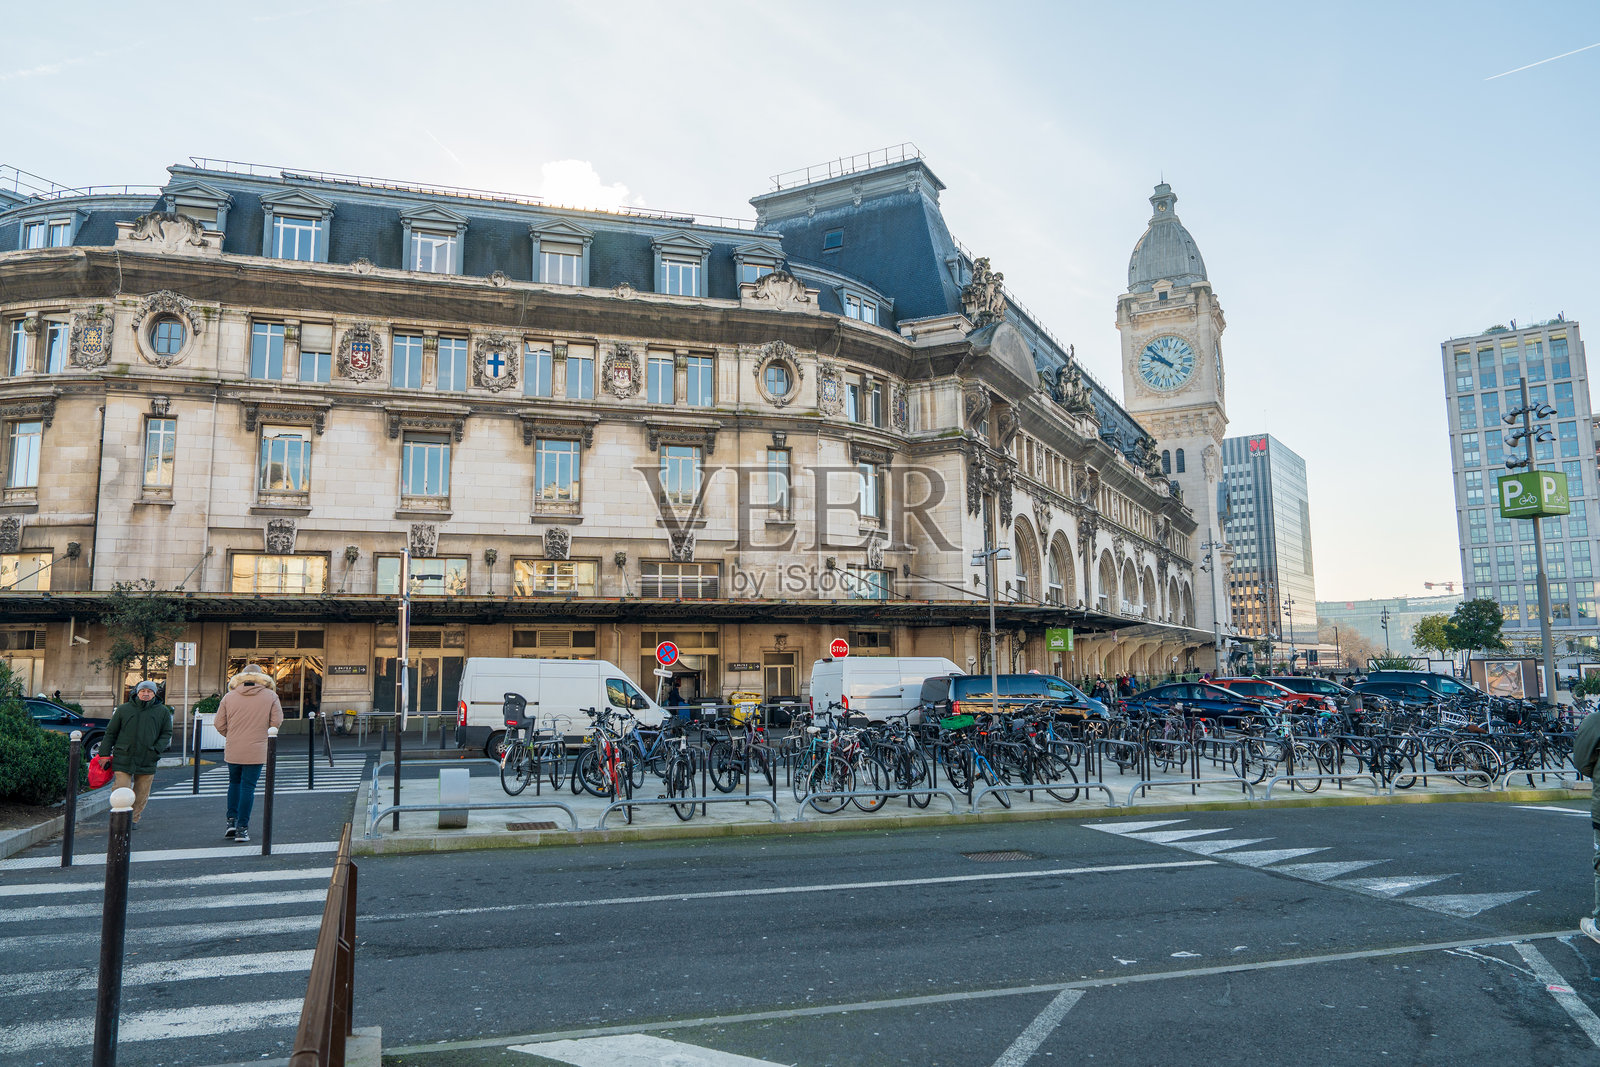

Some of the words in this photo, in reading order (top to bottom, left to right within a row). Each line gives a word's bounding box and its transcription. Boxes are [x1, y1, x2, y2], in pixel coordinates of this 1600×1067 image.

[1250, 450, 1267, 458] hotel
[1502, 480, 1523, 508] P
[1542, 476, 1556, 503] P
[832, 645, 847, 653] STOP
